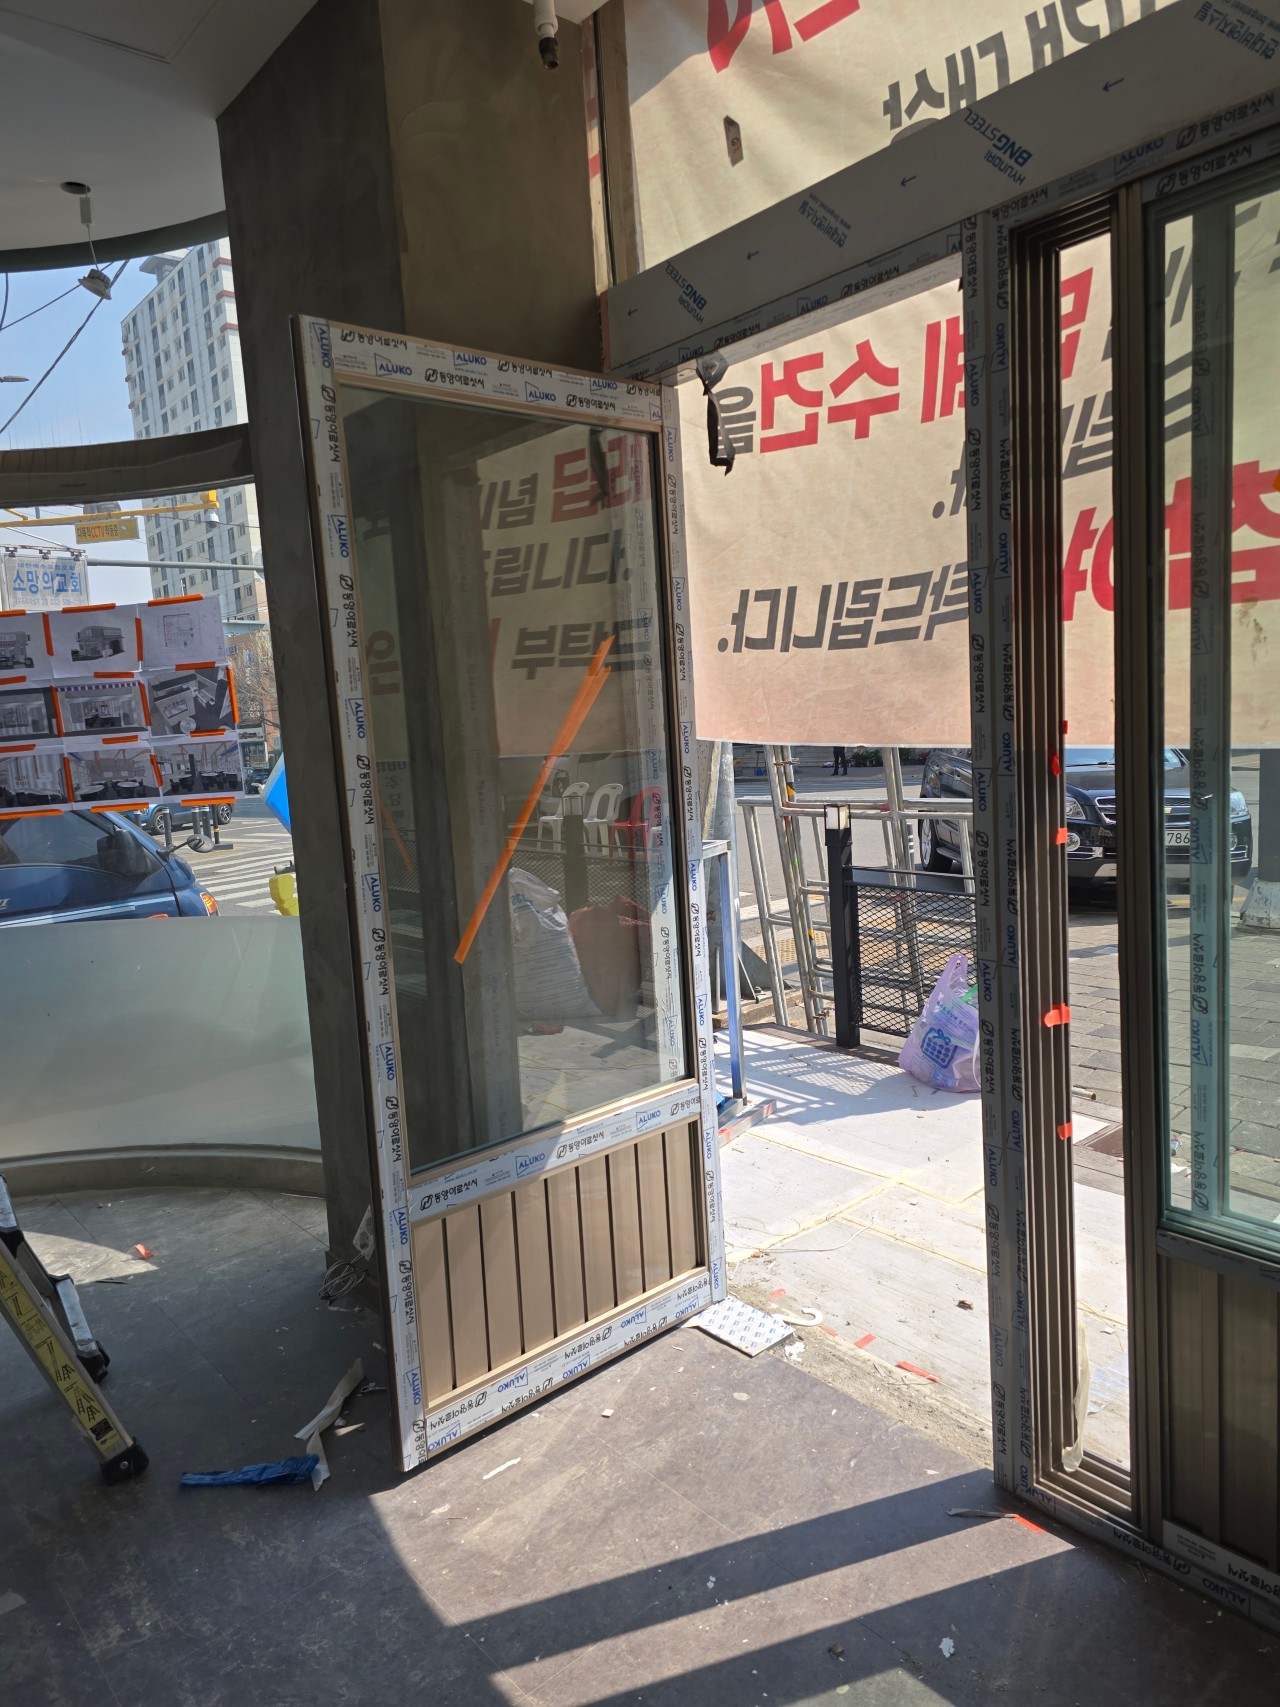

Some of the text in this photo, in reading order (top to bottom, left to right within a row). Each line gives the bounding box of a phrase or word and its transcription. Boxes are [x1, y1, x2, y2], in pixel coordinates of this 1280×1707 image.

[1195, 2, 1279, 59] 현대비앤지스틸
[984, 150, 1026, 185] HYUNDAI
[1118, 137, 1165, 165] ALUKO
[678, 295, 704, 324] HYUNDAI
[800, 295, 828, 314] ALUKO
[319, 327, 331, 368] ALUKO
[456, 352, 488, 366] ALUKO
[681, 346, 704, 361] ALUKO
[995, 322, 1007, 366] ALUKO
[379, 362, 413, 376] ALUKO
[592, 379, 618, 391] ALUKO
[969, 363, 980, 407] ALUKO
[529, 391, 556, 402] ALUKO
[337, 518, 350, 558] ALUKO
[998, 532, 1008, 574] ALUKO
[12, 569, 83, 596] 소망의교회
[973, 572, 983, 614] ALUKO
[354, 702, 366, 739] ALUKO
[1002, 732, 1012, 772] ALUKO
[977, 771, 987, 812] ALUKO
[1191, 817, 1199, 862] ALUKO
[370, 876, 381, 913] ALUKO
[1006, 924, 1016, 964] ALUKO
[983, 963, 992, 1002] ALUKO
[1191, 1018, 1200, 1061] ALUKO
[385, 1046, 395, 1081] ALUKO
[638, 1109, 661, 1124] ALUKO
[1009, 1110, 1020, 1148] ALUKO
[518, 1152, 546, 1169] ALUKO
[988, 1148, 998, 1187] ALUKO
[398, 1211, 409, 1246] ALUKO
[620, 1311, 645, 1329] ALUKO
[675, 1302, 698, 1319] ALUKO
[1016, 1290, 1025, 1327] ALUKO
[994, 1328, 1004, 1367] ALUKO
[497, 1372, 526, 1393] ALUKO
[562, 1360, 589, 1379] ALUKO
[411, 1371, 421, 1406] ALUKO
[427, 1429, 459, 1453] ALUKO
[1202, 1577, 1246, 1605] ALUKO
